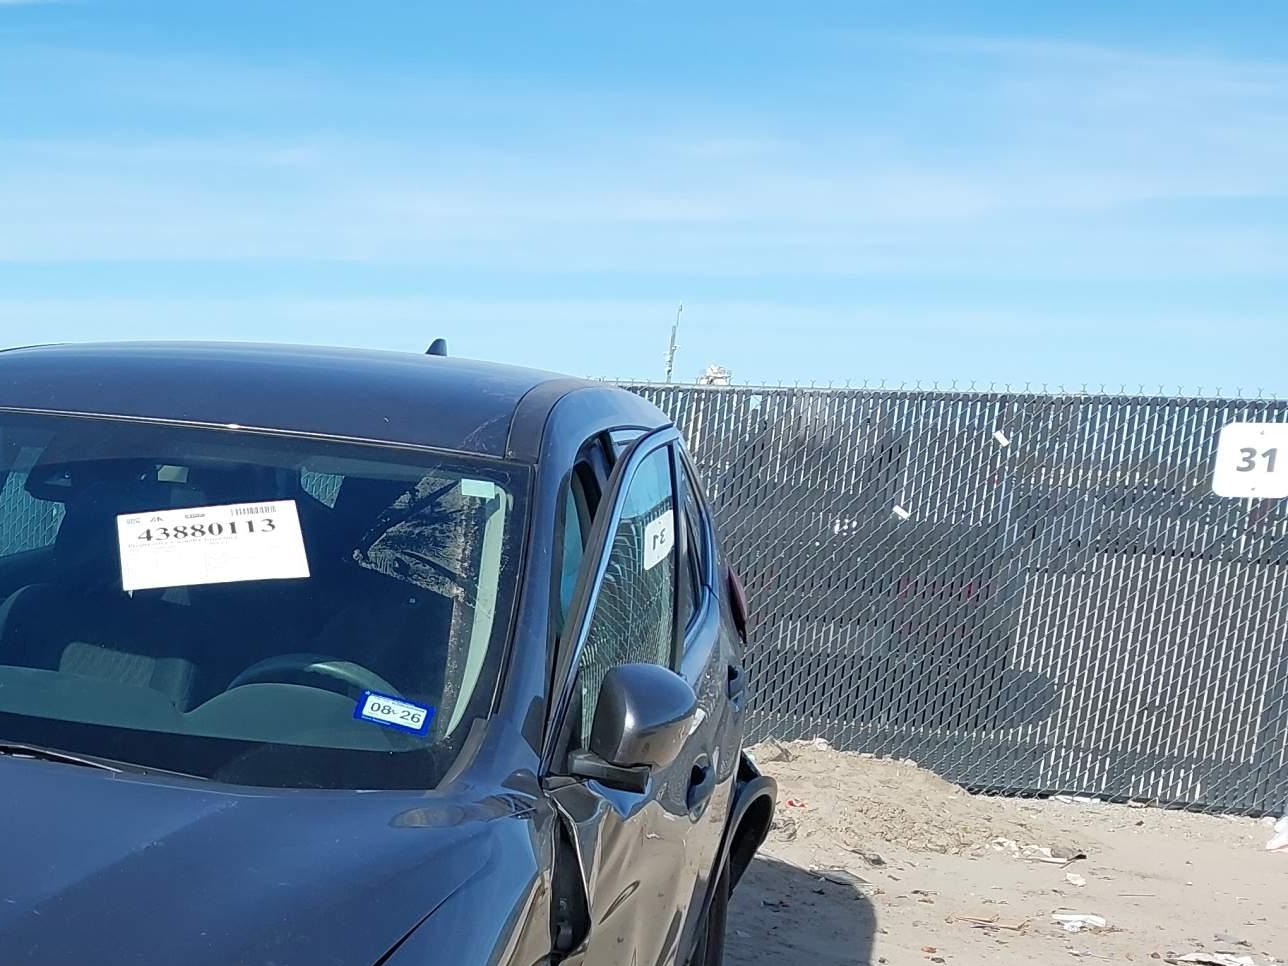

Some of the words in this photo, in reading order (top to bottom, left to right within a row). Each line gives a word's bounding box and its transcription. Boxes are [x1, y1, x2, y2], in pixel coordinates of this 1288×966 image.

[1236, 447, 1278, 473] 31
[137, 518, 276, 541] 43880113
[370, 702, 392, 715] 08
[399, 710, 422, 723] 26
